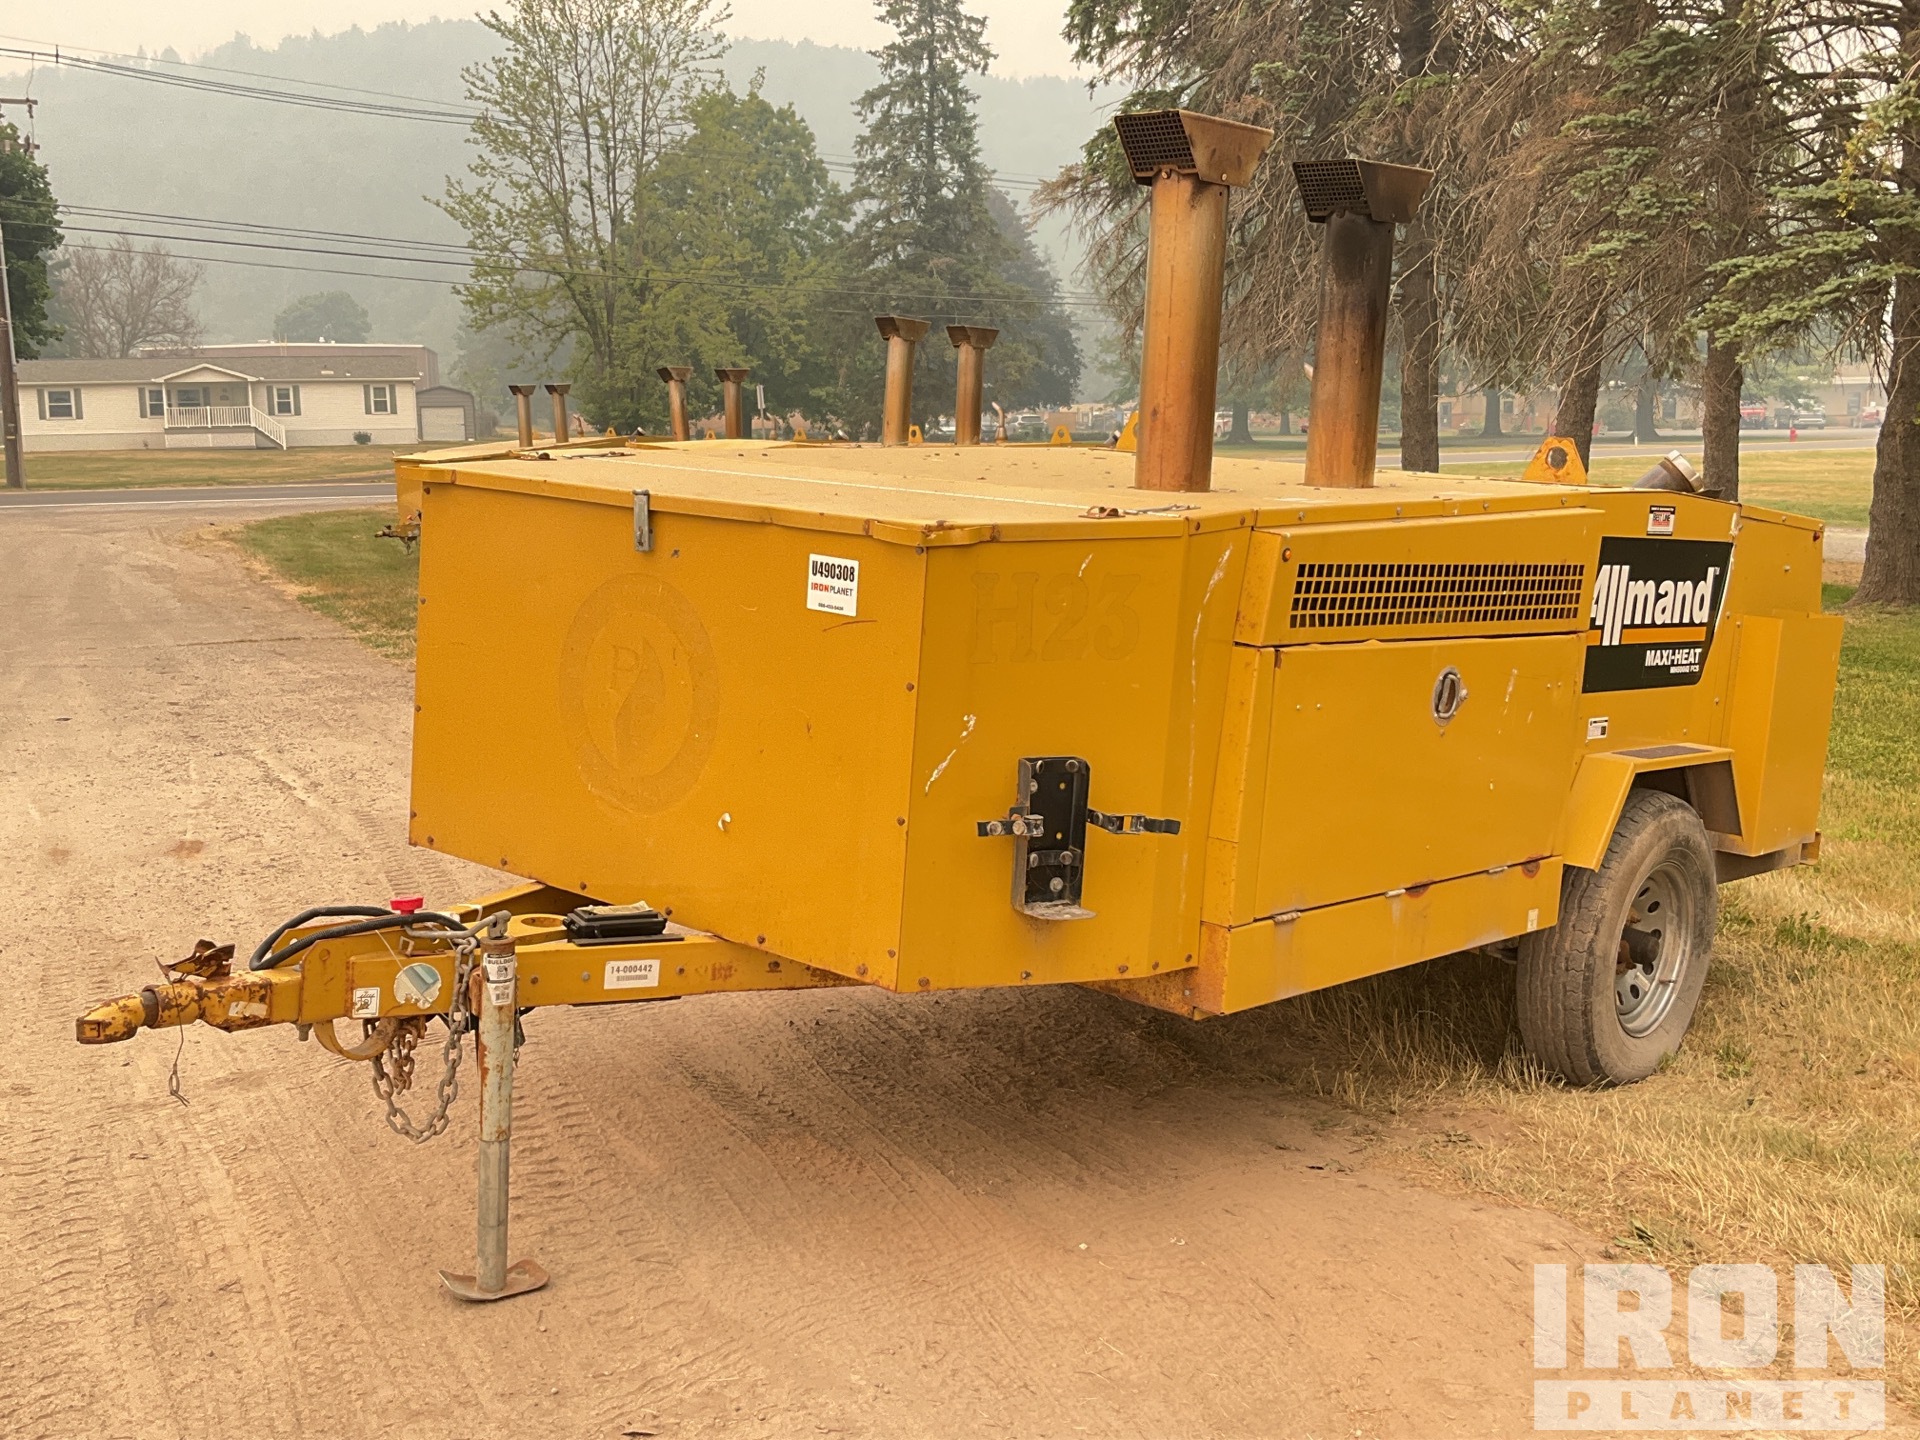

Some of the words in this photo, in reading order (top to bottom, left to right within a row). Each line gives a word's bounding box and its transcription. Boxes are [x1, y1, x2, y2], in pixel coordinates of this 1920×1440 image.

[811, 560, 855, 582] U490308
[1590, 564, 1714, 647] Allmand
[967, 571, 1141, 664] H23
[1645, 648, 1702, 666] MAXI-HEAT
[611, 964, 653, 974] 14-000442
